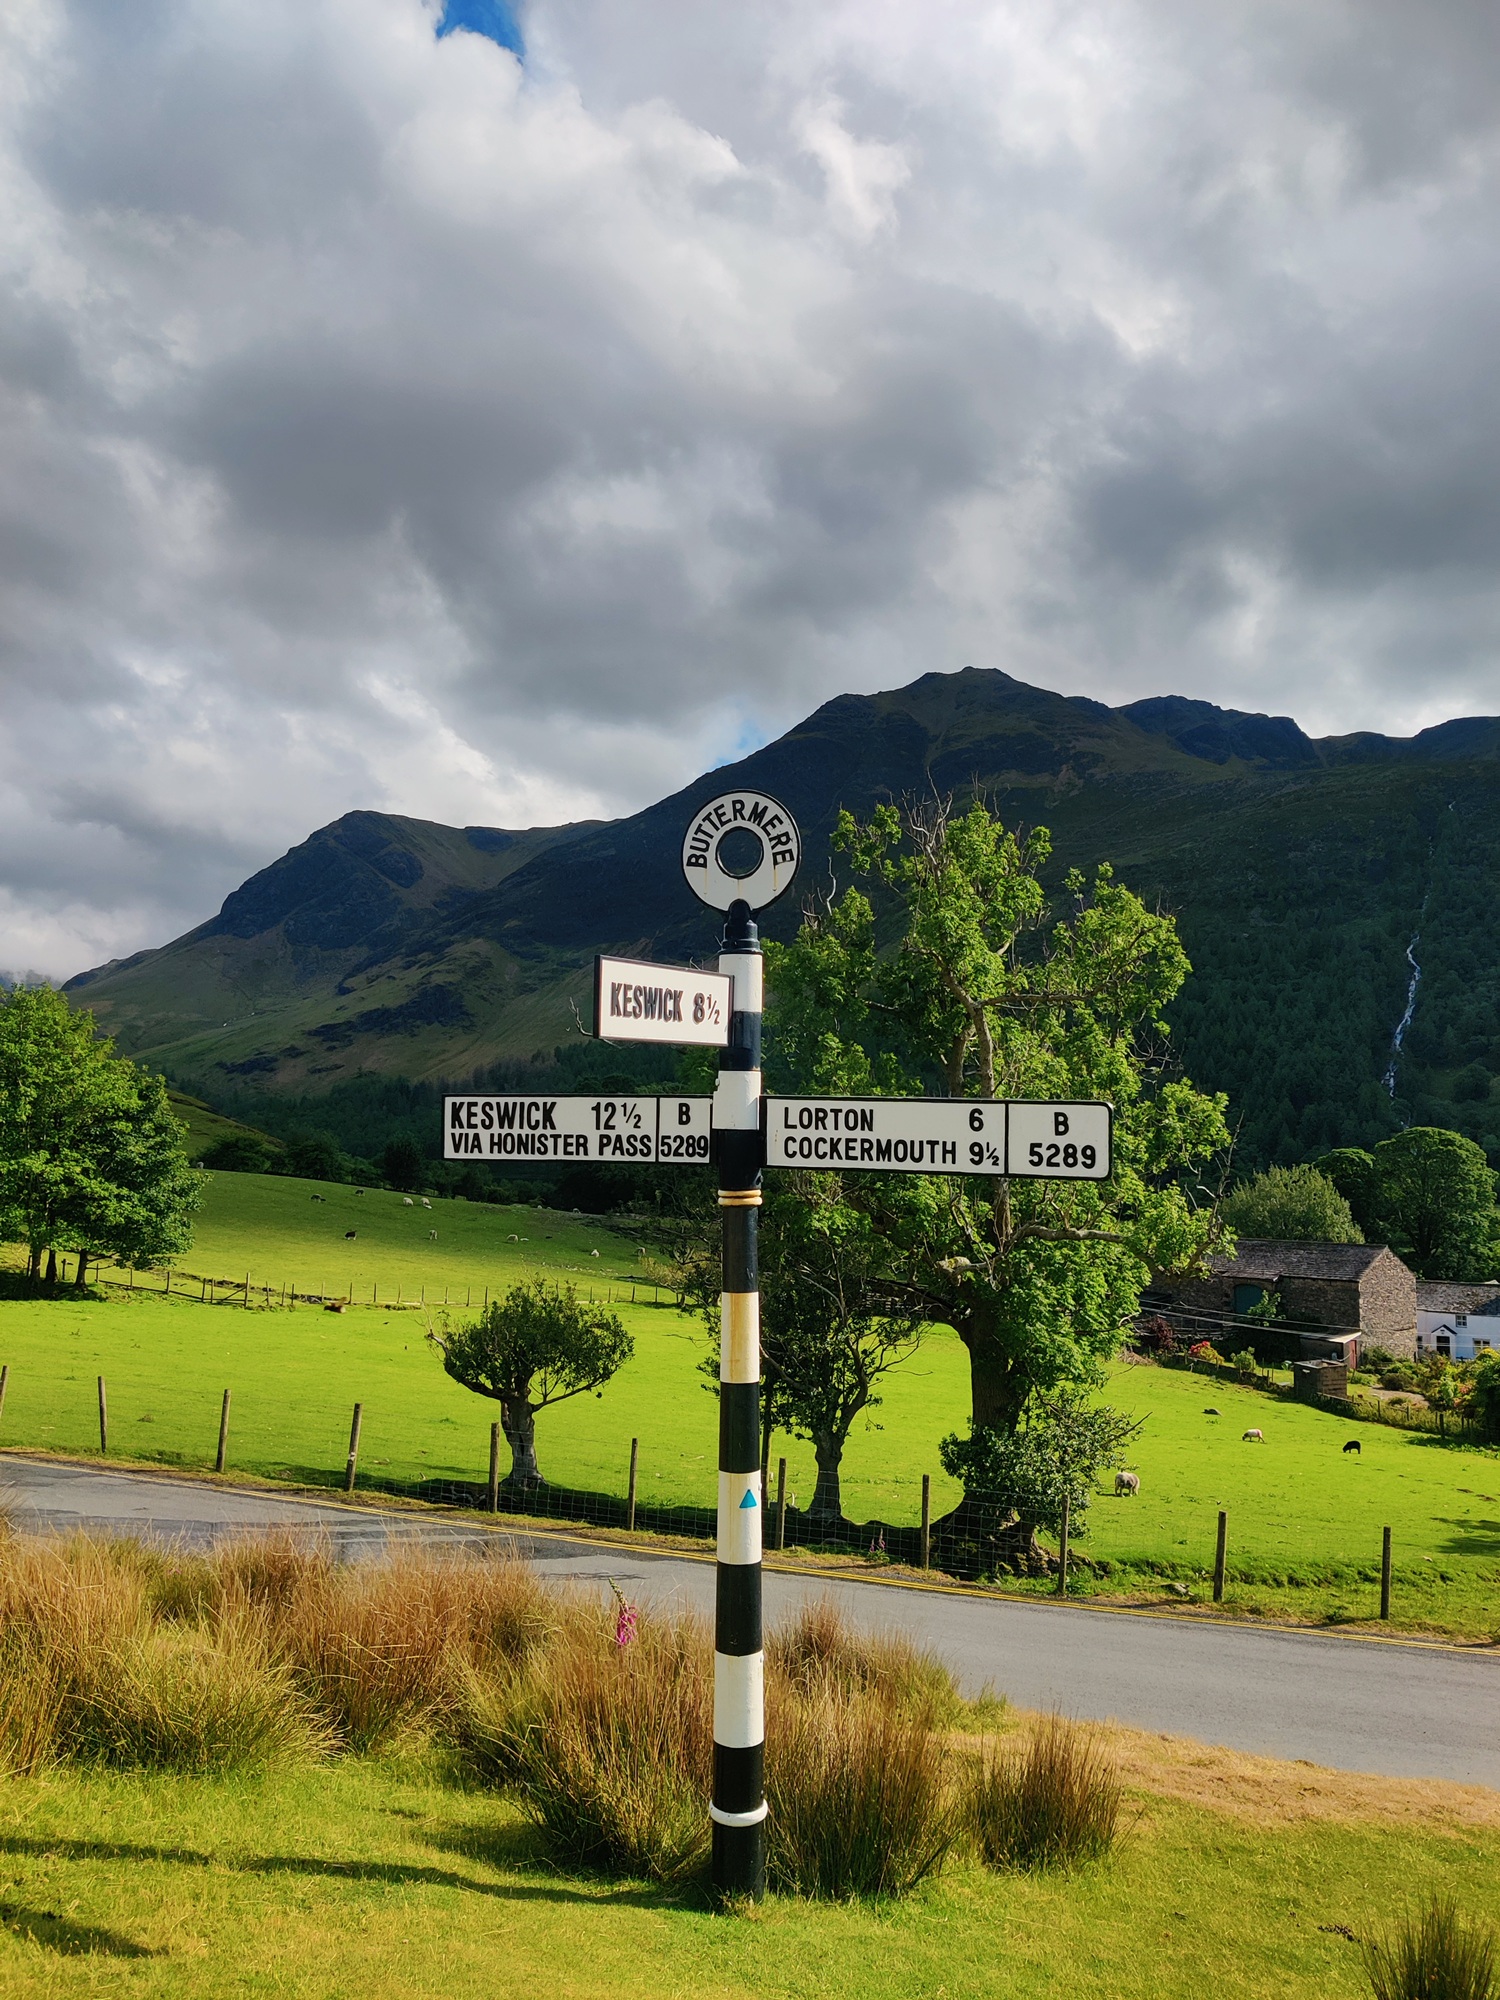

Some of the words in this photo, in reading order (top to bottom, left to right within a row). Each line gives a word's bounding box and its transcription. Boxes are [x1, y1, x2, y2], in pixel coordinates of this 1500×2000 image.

[686, 799, 795, 869] BUTTERMERE
[610, 981, 684, 1023] KESWICK
[450, 1101, 557, 1131] KESWICK
[678, 1102, 691, 1126] B
[784, 1106, 874, 1132] LORTON
[968, 1107, 985, 1132] 6
[1053, 1111, 1070, 1137] B
[451, 1132, 483, 1154] VIA
[489, 1132, 589, 1157] HONISTER
[599, 1133, 652, 1158] PASS
[660, 1134, 709, 1158] 5289
[784, 1136, 957, 1165] COCKERMOUTH
[1028, 1142, 1097, 1170] 5289
